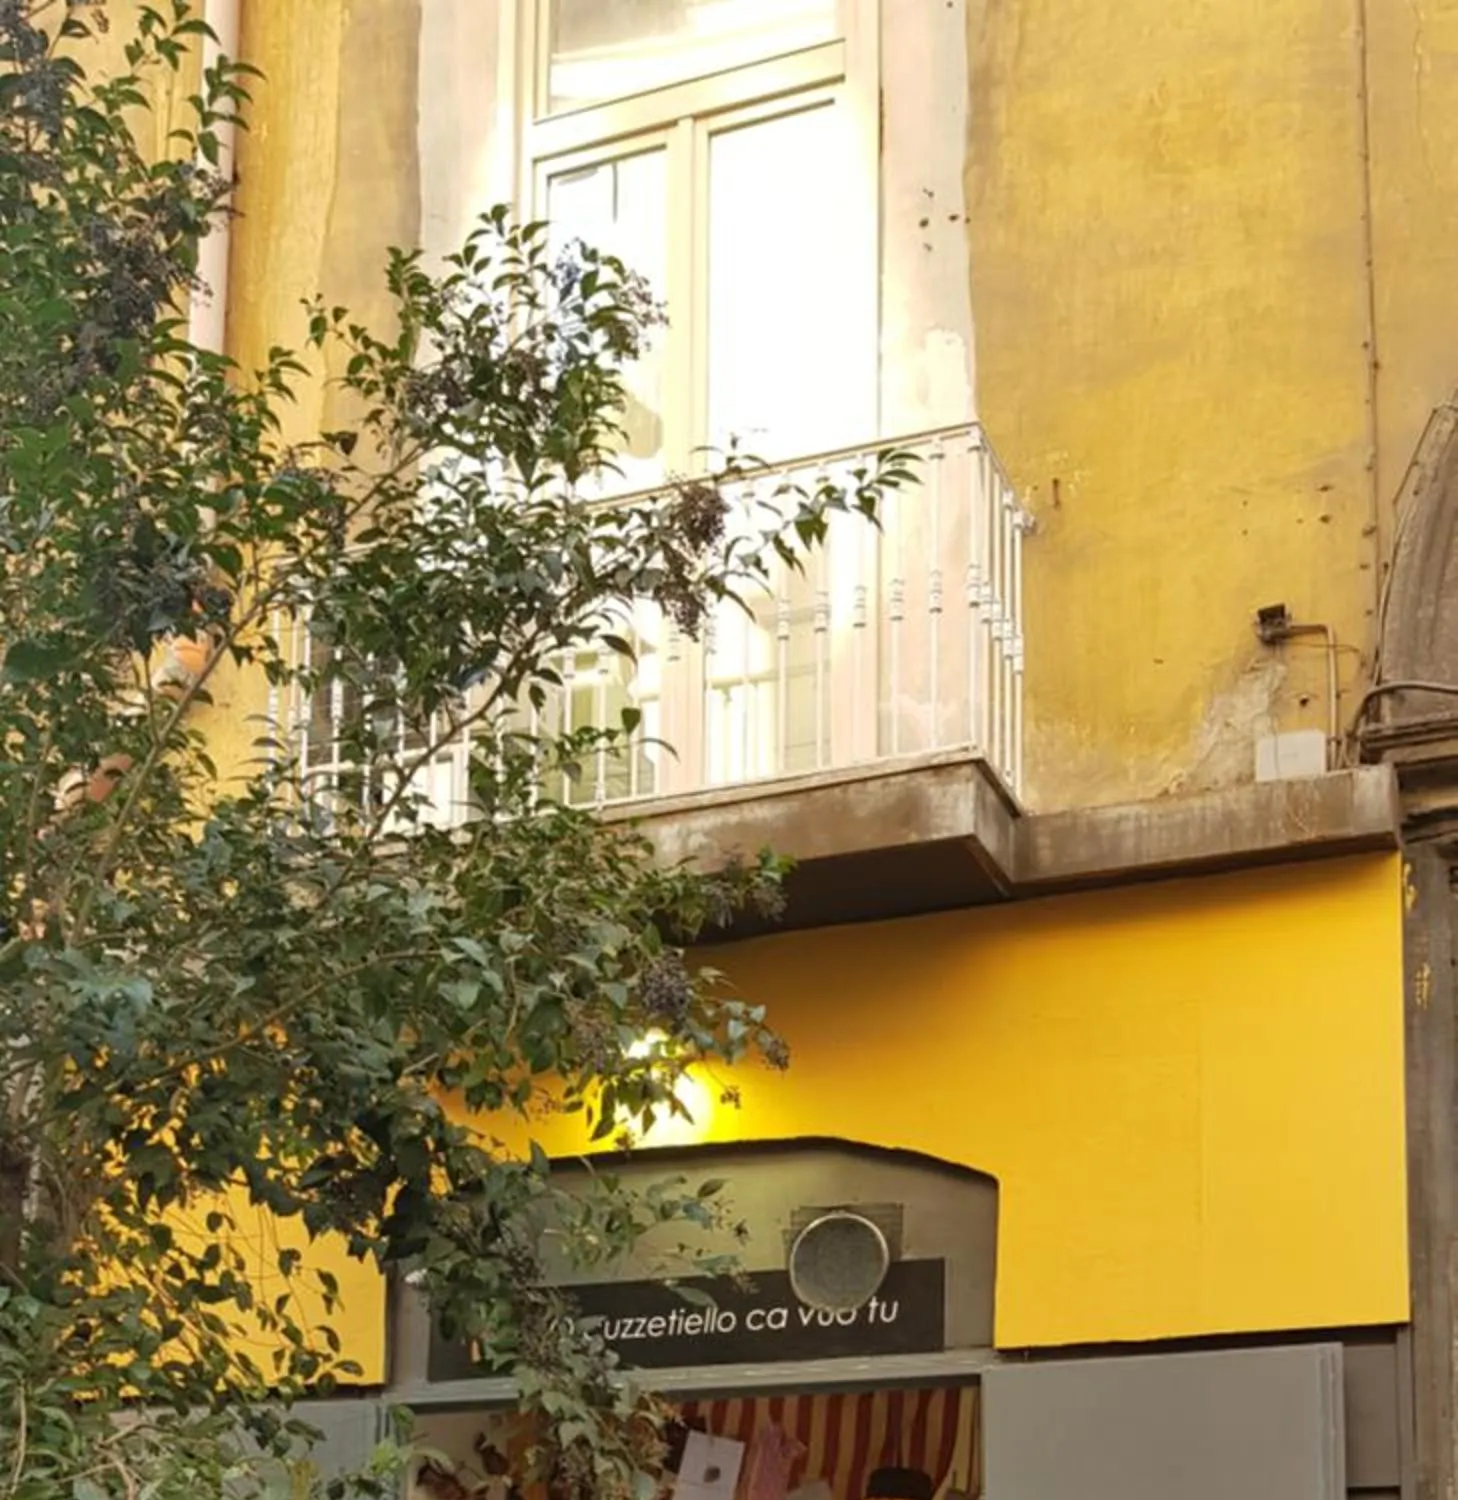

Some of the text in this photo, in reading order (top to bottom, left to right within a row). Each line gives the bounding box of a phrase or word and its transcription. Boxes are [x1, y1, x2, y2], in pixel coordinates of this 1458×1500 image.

[583, 1303, 737, 1341] uzzetiello
[745, 1307, 788, 1331] ca
[867, 1295, 899, 1324] tu
